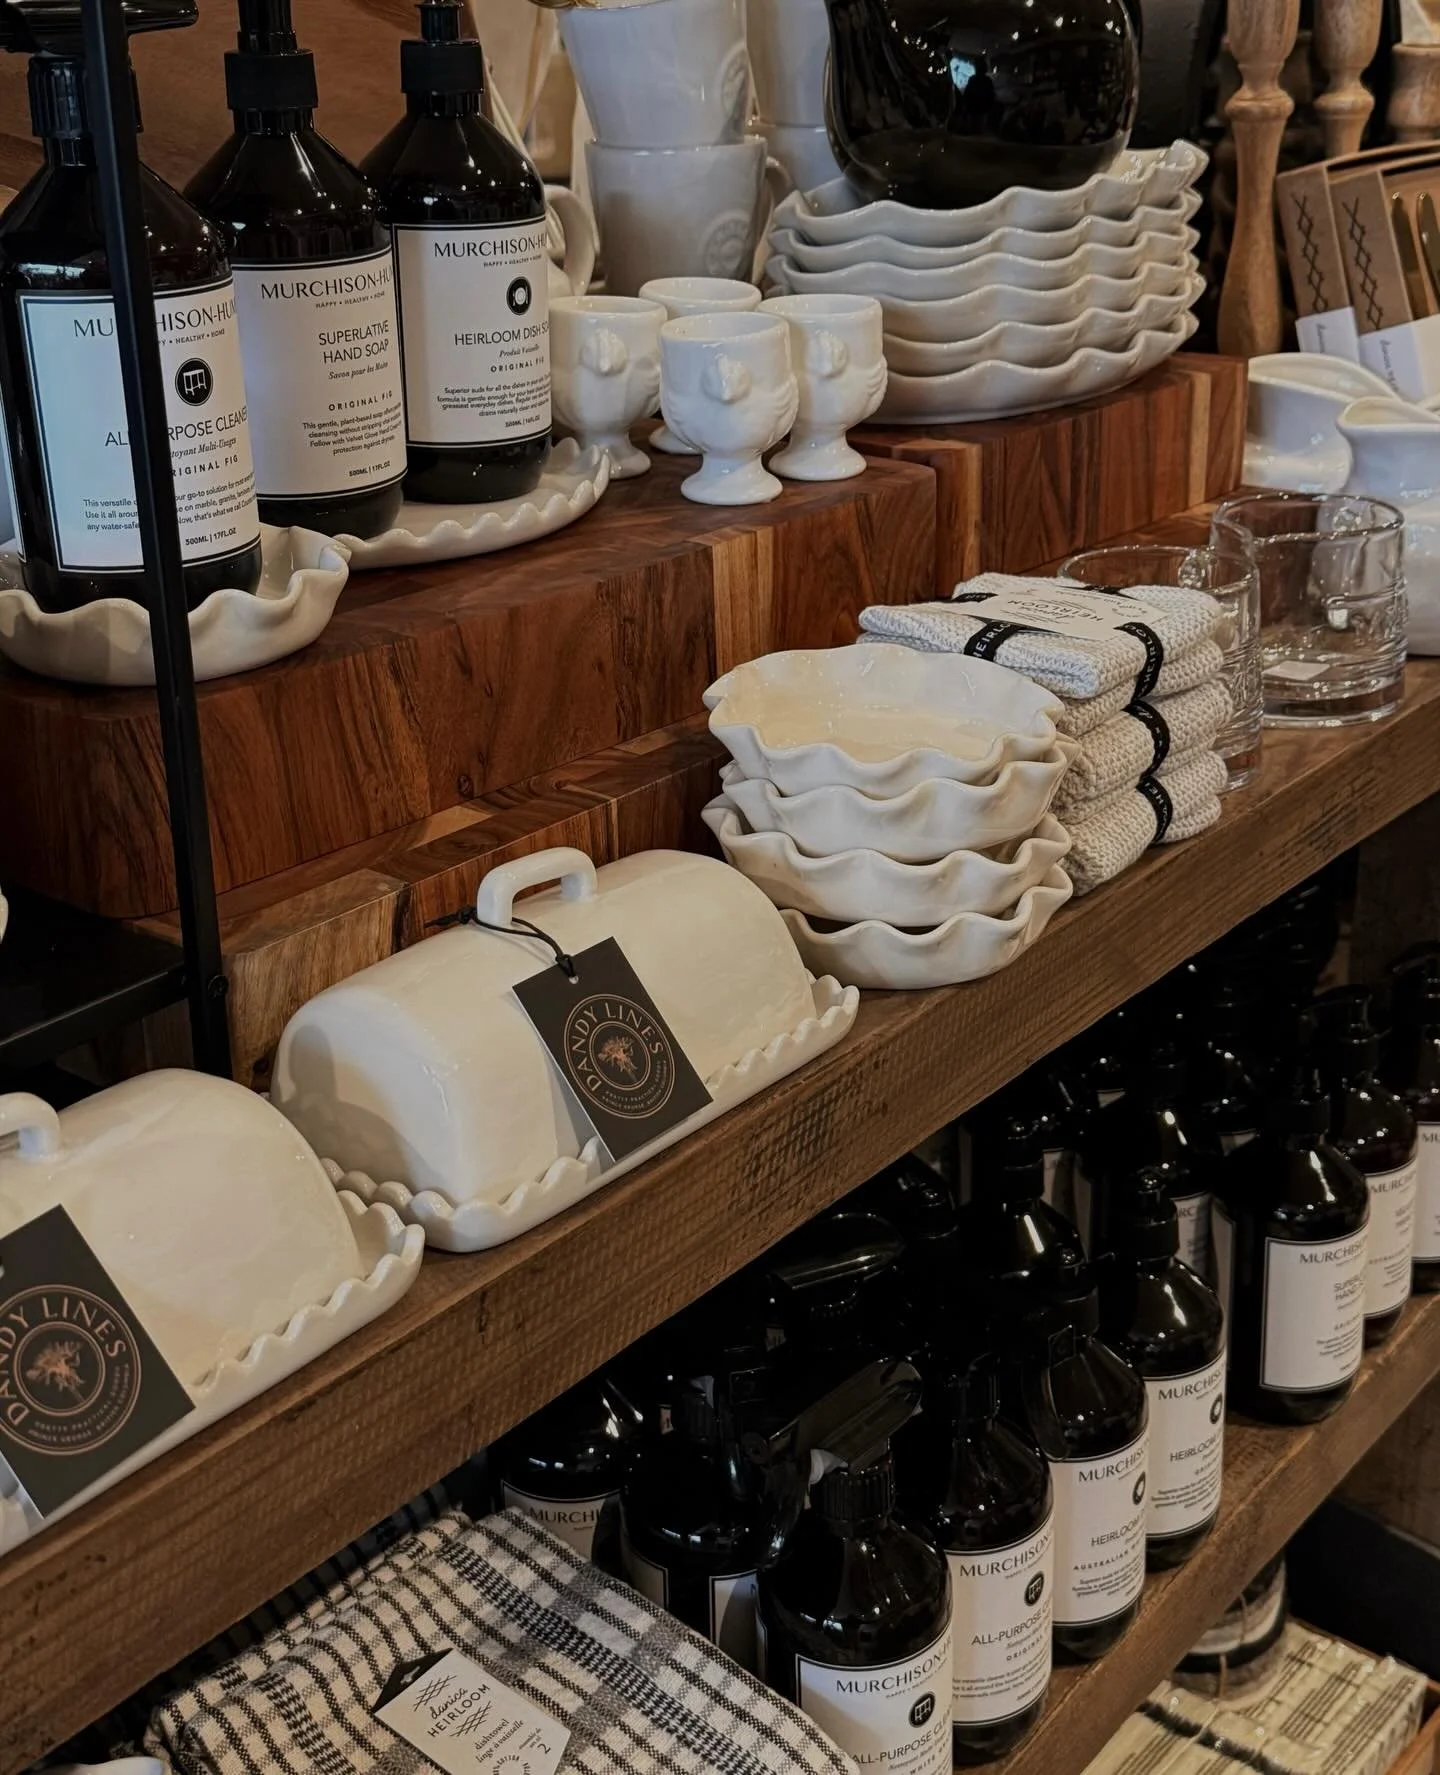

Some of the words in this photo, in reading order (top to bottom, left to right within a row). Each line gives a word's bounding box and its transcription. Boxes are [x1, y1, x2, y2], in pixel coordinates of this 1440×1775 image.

[315, 301, 337, 309] HAPPY
[175, 333, 205, 345] HEALTHY
[318, 319, 389, 346] SUPERLATIVE
[454, 329, 521, 346] HEIRLOOM
[523, 325, 541, 340] DISH
[323, 346, 362, 364] HAND
[365, 338, 389, 358] SOAP
[328, 370, 350, 380] Savon
[351, 367, 366, 379] pour
[490, 360, 533, 373] ORIGINAL
[328, 395, 379, 412] ORIGINAL
[308, 428, 339, 440] cleansing
[332, 443, 363, 456] protection
[171, 459, 221, 478] RIGINAL
[224, 454, 239, 466] FIG
[82, 499, 100, 508] This
[100, 498, 132, 508] versatile
[187, 489, 206, 501] go-to
[205, 484, 228, 496] solution
[85, 510, 100, 520] Use
[107, 509, 118, 520] all
[184, 504, 194, 512] on
[86, 522, 101, 533] any
[193, 511, 212, 522] that's
[185, 534, 209, 546] 500ML
[571, 1004, 603, 1093] DANDY
[604, 1001, 664, 1055] LINES
[41, 1297, 127, 1359] LINES
[971, 1607, 1043, 1646] ALL-PURPOSE
[427, 1683, 491, 1738] HEIRLOOM
[429, 1687, 469, 1720] danica
[474, 1717, 510, 1751] dishtowel
[475, 1747, 494, 1763] linge
[498, 1719, 525, 1744] vaisselle
[537, 1743, 552, 1754] 2
[850, 1729, 933, 1765] ALL-PURPOSE
